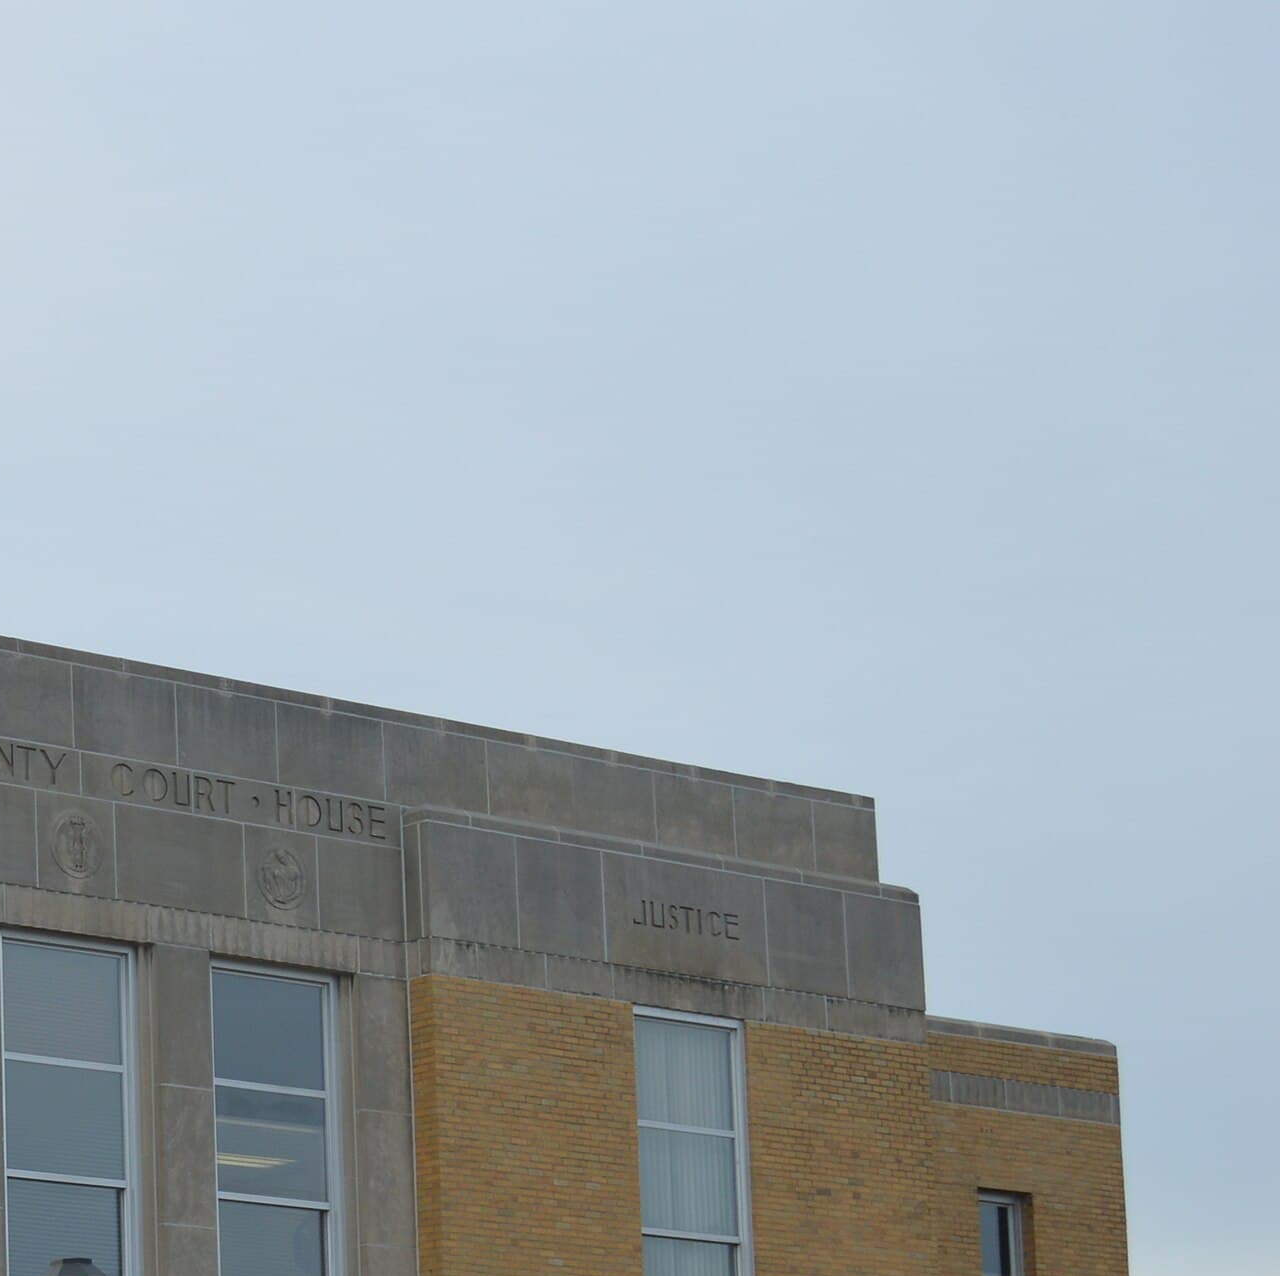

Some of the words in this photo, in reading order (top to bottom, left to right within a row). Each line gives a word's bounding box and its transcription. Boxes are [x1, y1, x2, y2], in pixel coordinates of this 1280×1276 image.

[110, 762, 236, 814] COURT
[274, 788, 386, 841] HOUSE
[632, 899, 740, 941] JUSTICE
